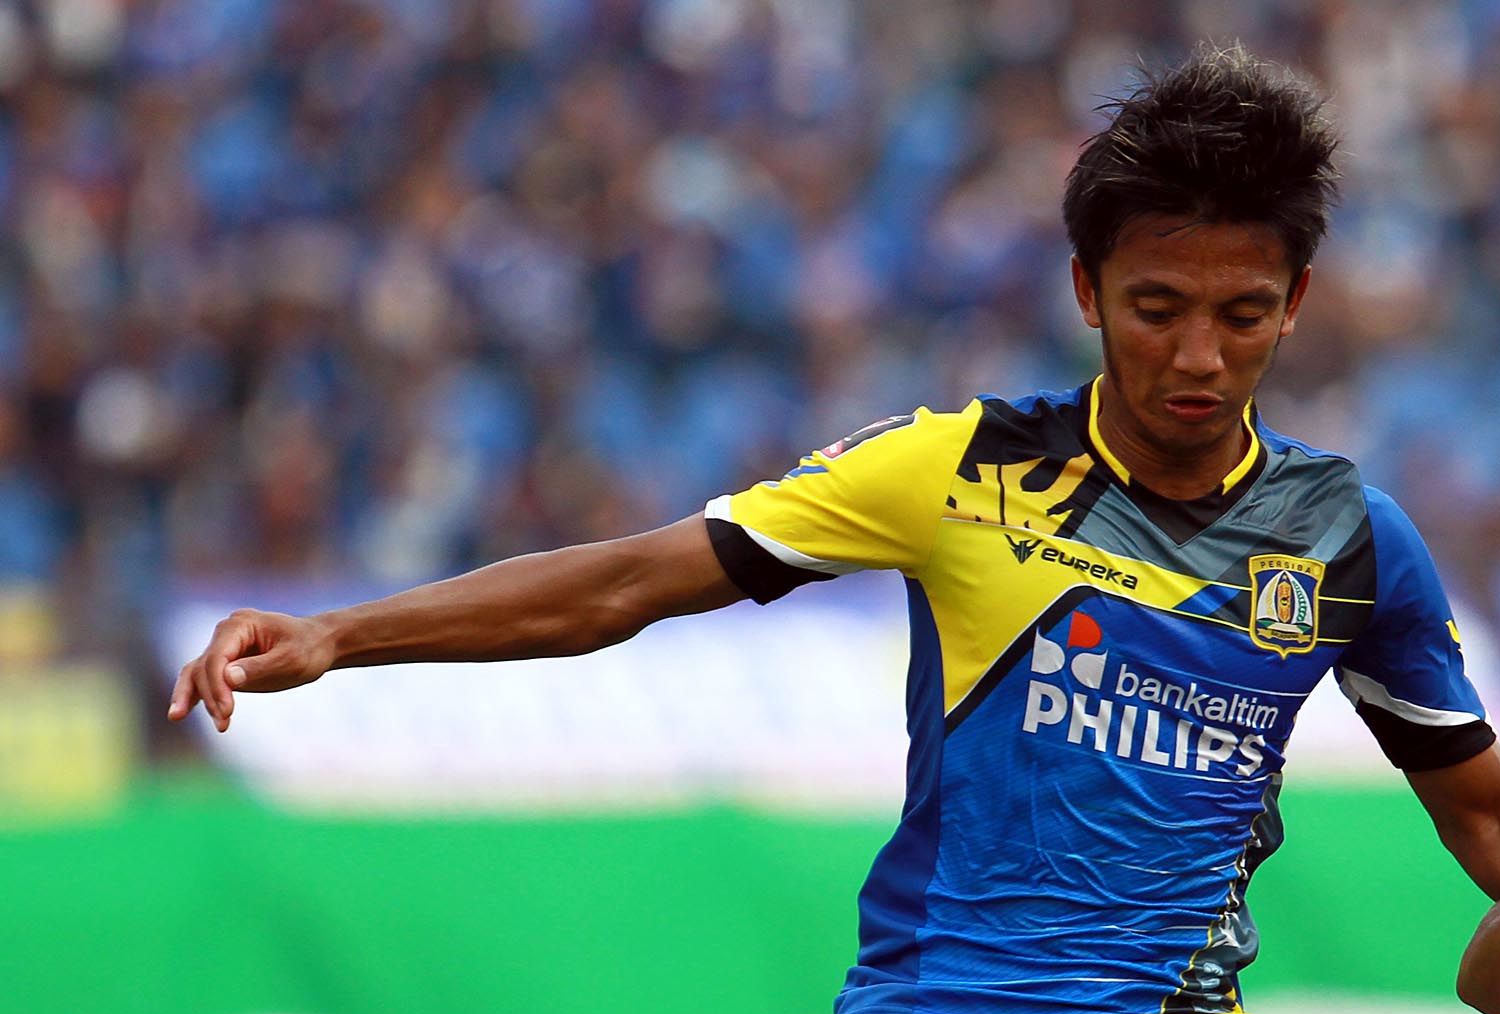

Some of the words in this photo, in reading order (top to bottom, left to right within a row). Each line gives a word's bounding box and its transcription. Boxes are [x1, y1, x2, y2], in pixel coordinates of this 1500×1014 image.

[1260, 560, 1312, 575] PERSIBA
[1022, 679, 1267, 777] PHILIPS
[1115, 663, 1280, 730] bankaltim
